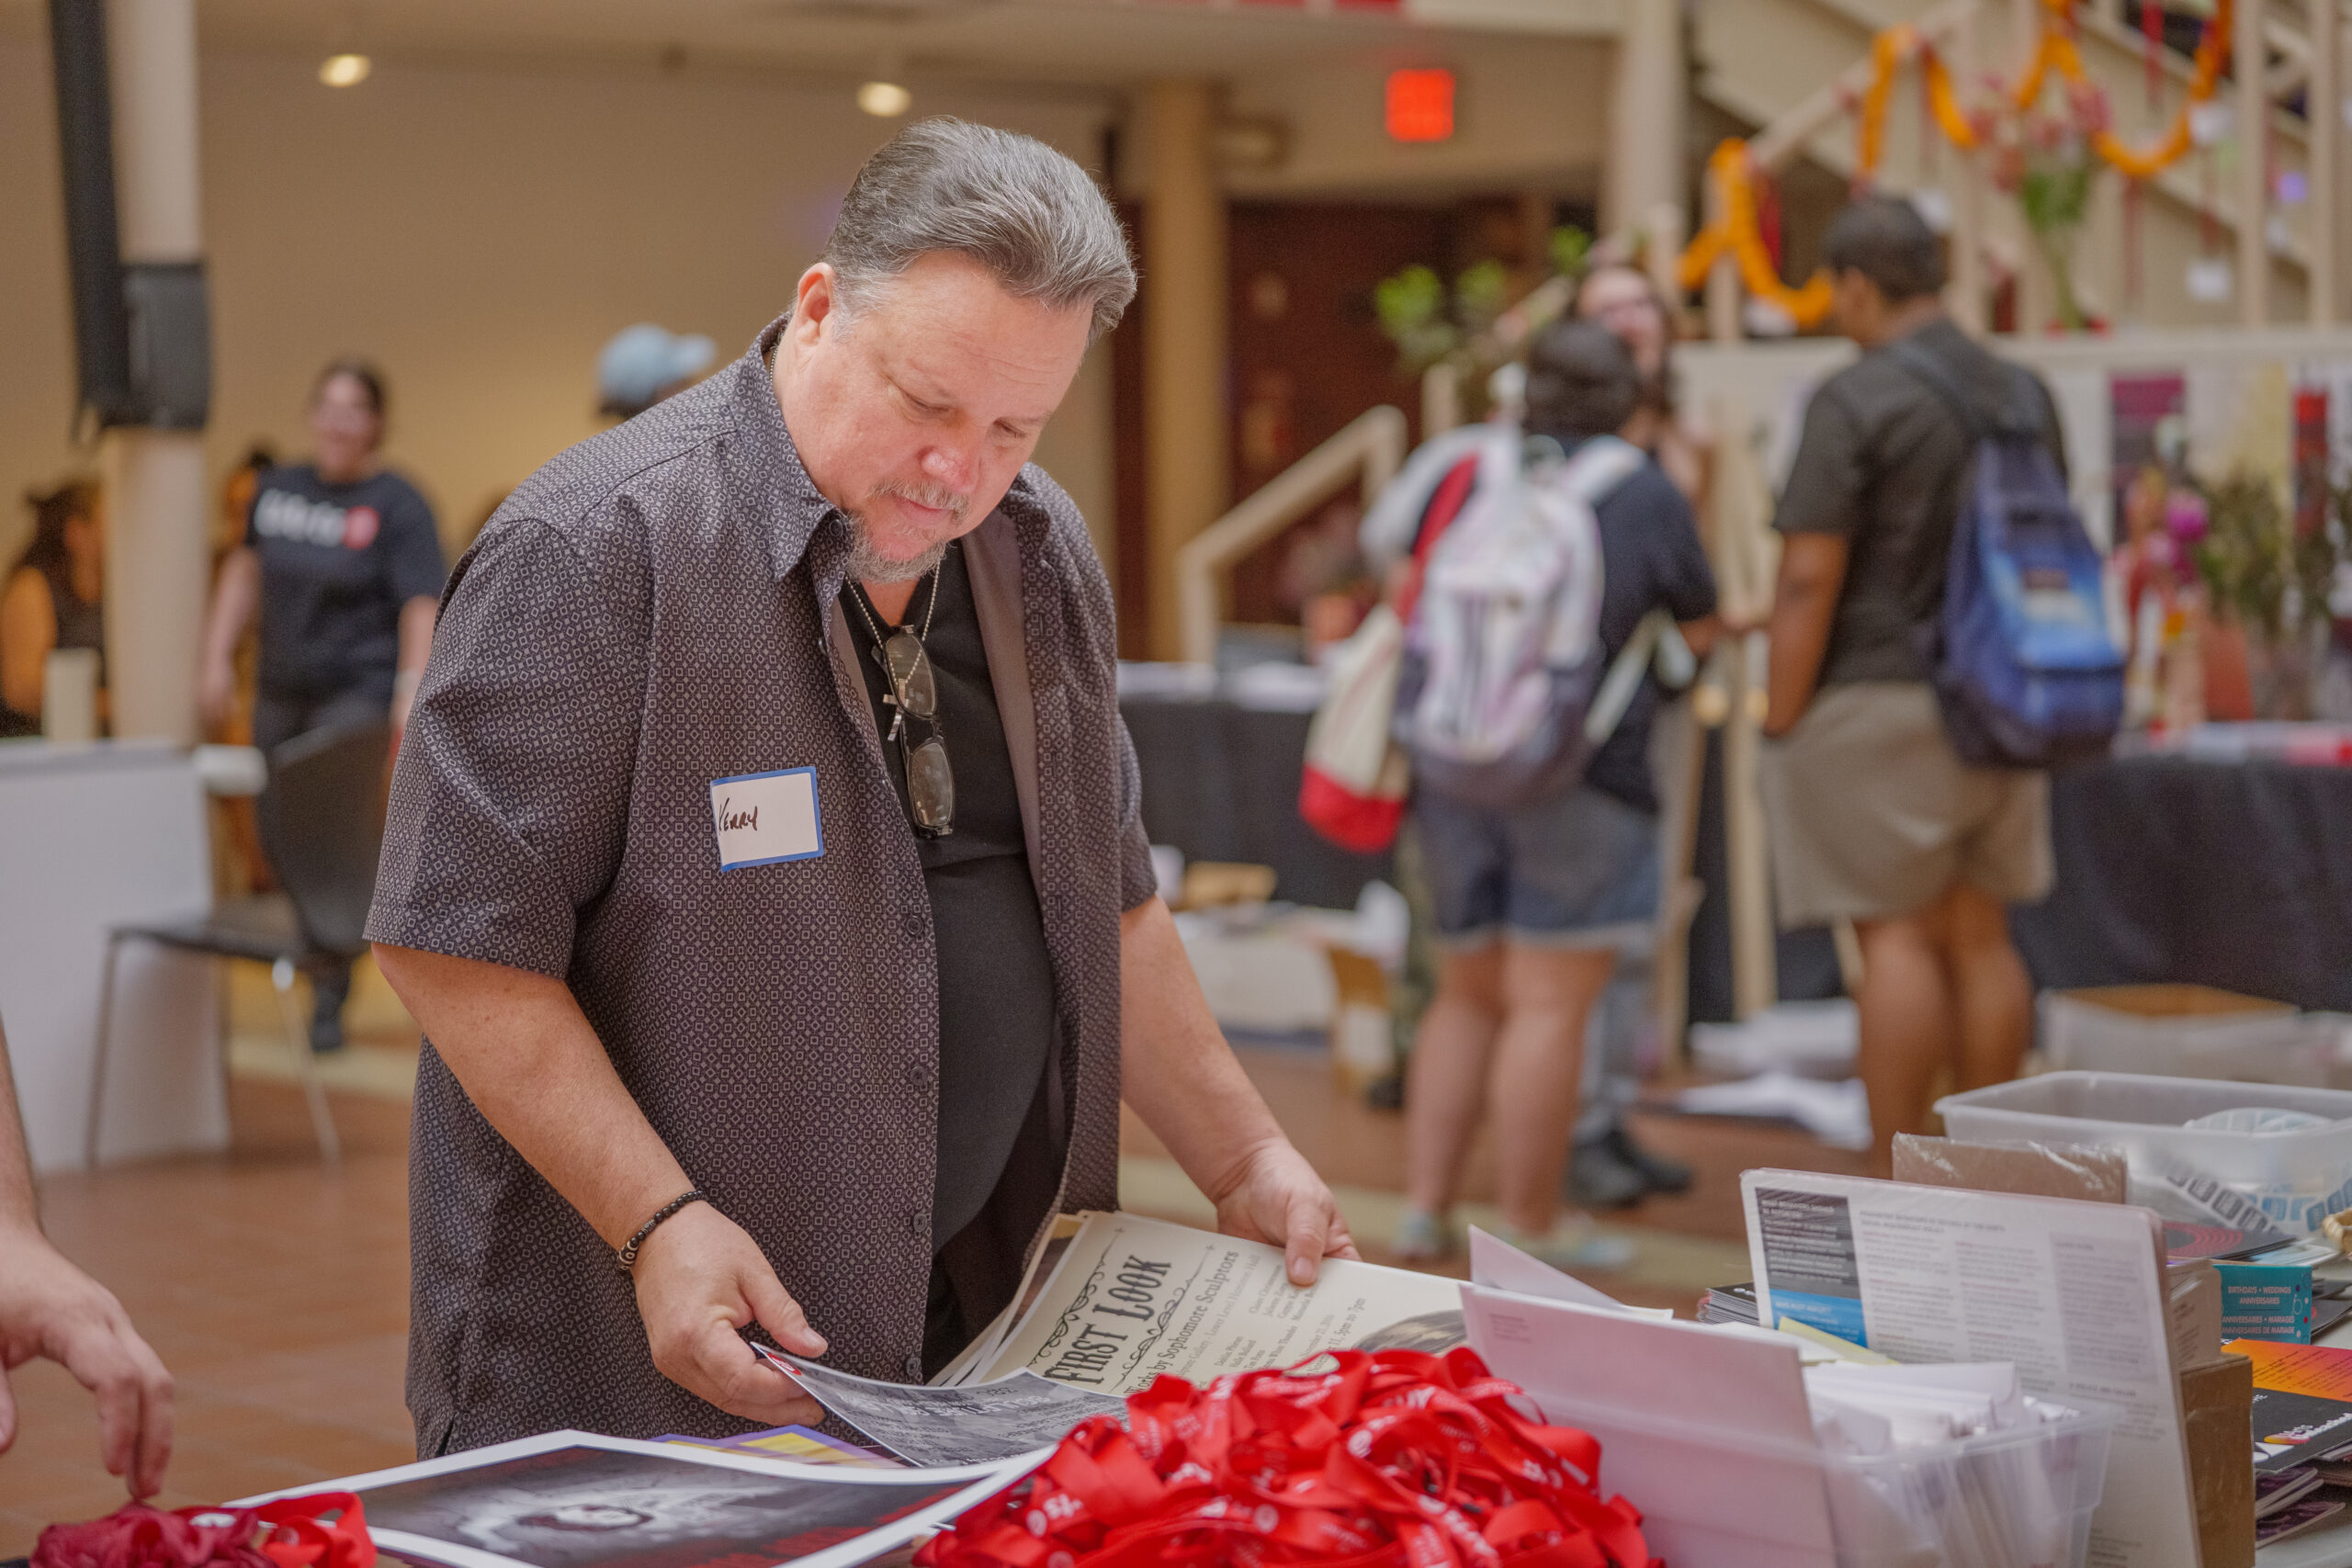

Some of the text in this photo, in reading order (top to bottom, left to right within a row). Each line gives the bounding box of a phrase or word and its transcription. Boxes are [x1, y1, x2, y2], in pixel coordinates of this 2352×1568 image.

[1195, 1250, 1239, 1304] Sculptors
[1043, 1323, 1128, 1384] FIRST
[1092, 1255, 1172, 1323] LOOK
[1158, 1303, 1208, 1359] Sophomore
[1147, 1360, 1173, 1371] by
